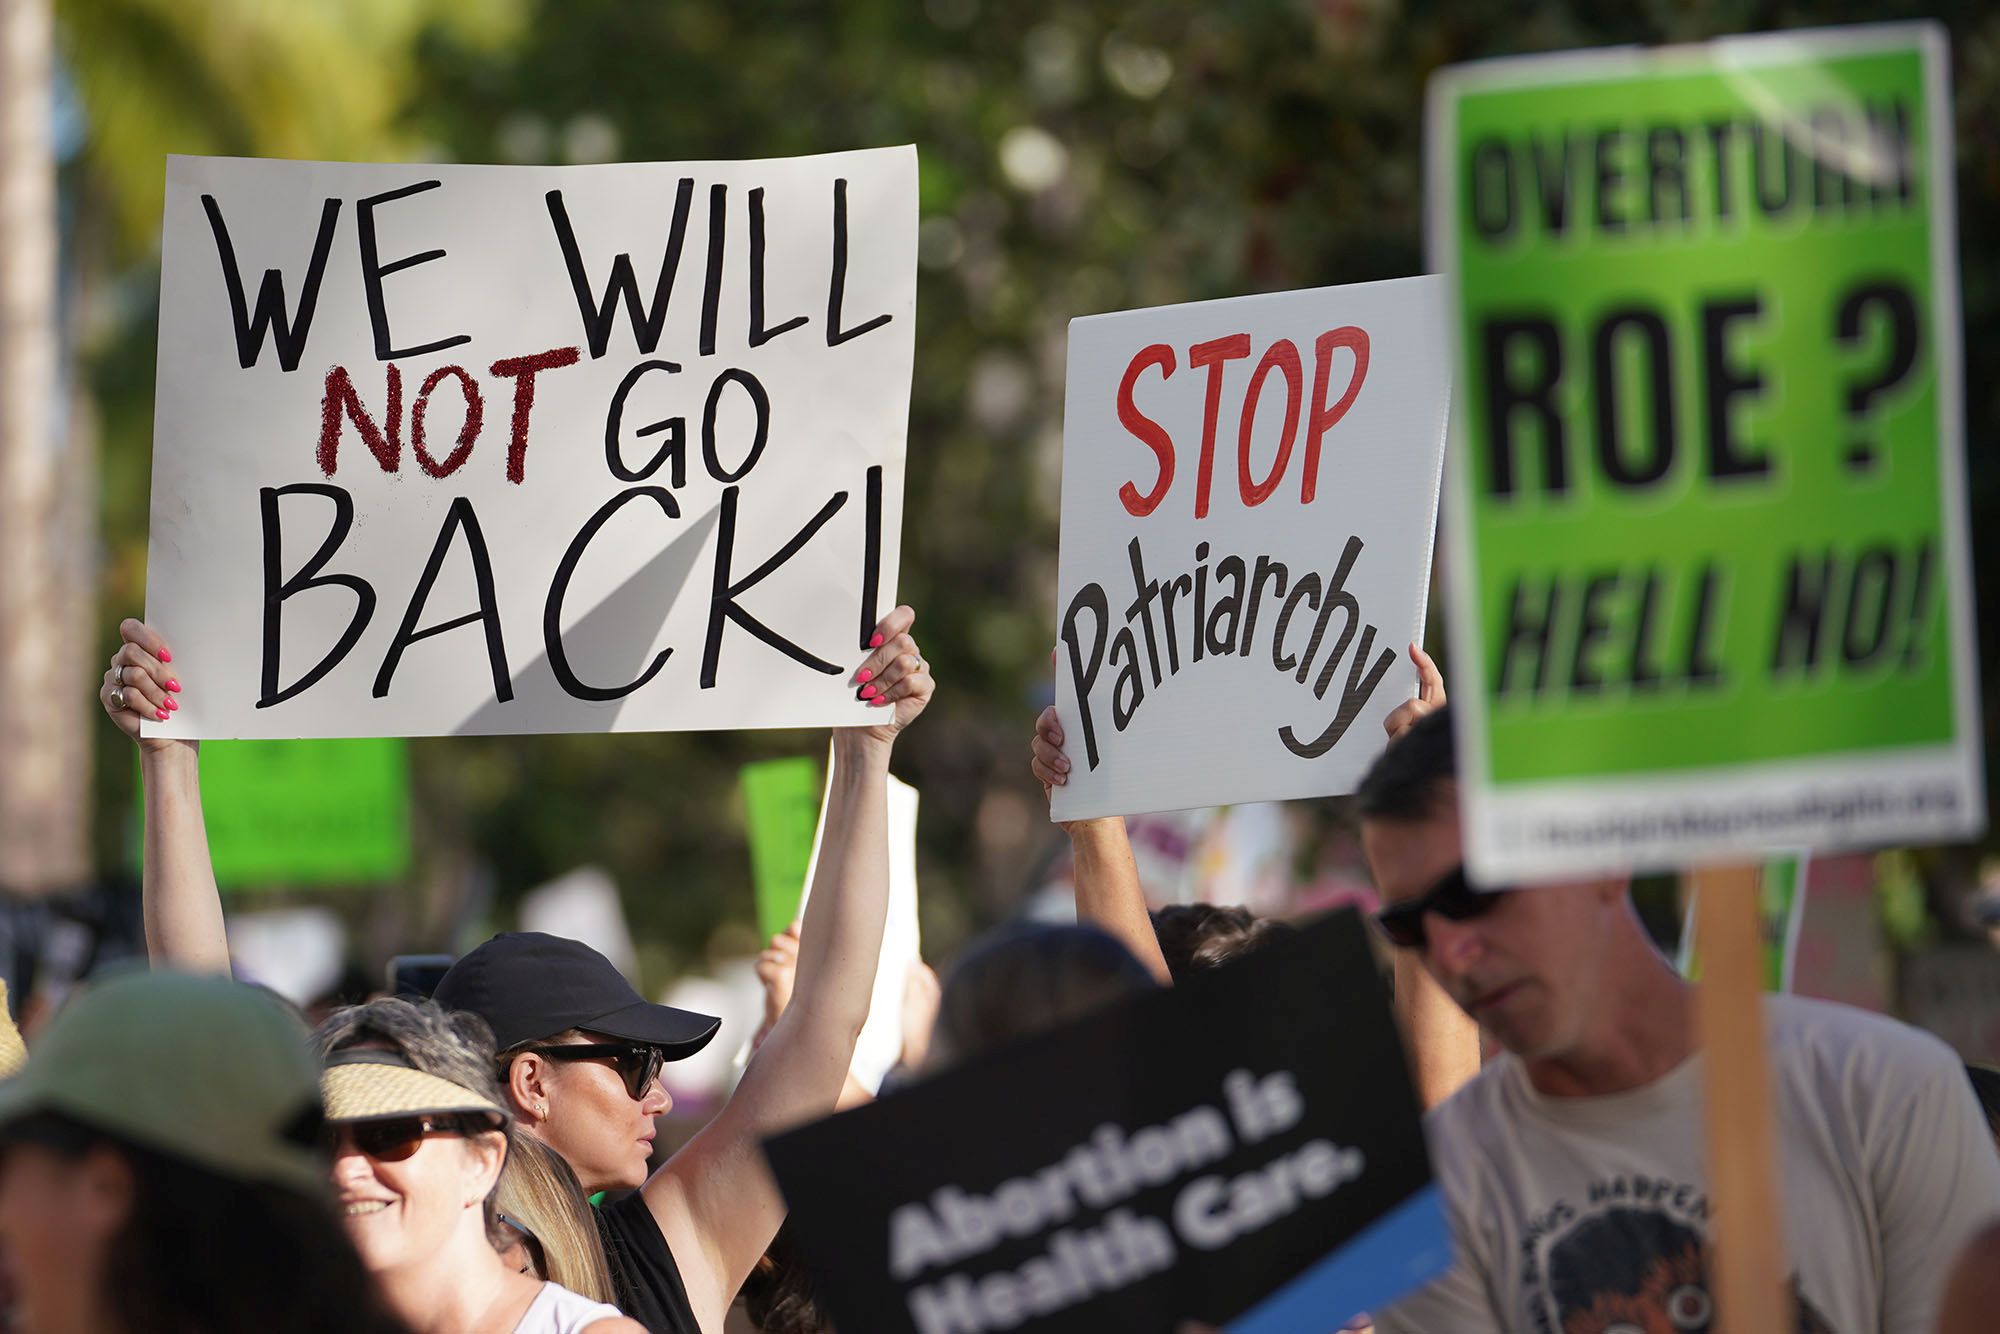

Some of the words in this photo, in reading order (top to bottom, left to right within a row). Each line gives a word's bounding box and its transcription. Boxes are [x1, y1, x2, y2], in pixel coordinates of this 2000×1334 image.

[1473, 102, 1910, 236] OVERTURN
[201, 179, 472, 372] WE
[545, 177, 893, 359] WILL
[316, 346, 582, 485] NOT
[605, 359, 771, 488] GO
[1116, 325, 1371, 520] STOP
[1482, 292, 1770, 497] ROE
[1835, 280, 1920, 470] ?
[255, 465, 882, 709] BACK!
[1060, 535, 1397, 772] Patriarchy
[1496, 562, 1721, 697] HELL
[1771, 536, 1935, 677] NO!
[889, 1100, 1232, 1279] Abortion
[1223, 1067, 1304, 1144] is
[907, 1207, 1176, 1334] Health
[1173, 1139, 1366, 1250] Care.
